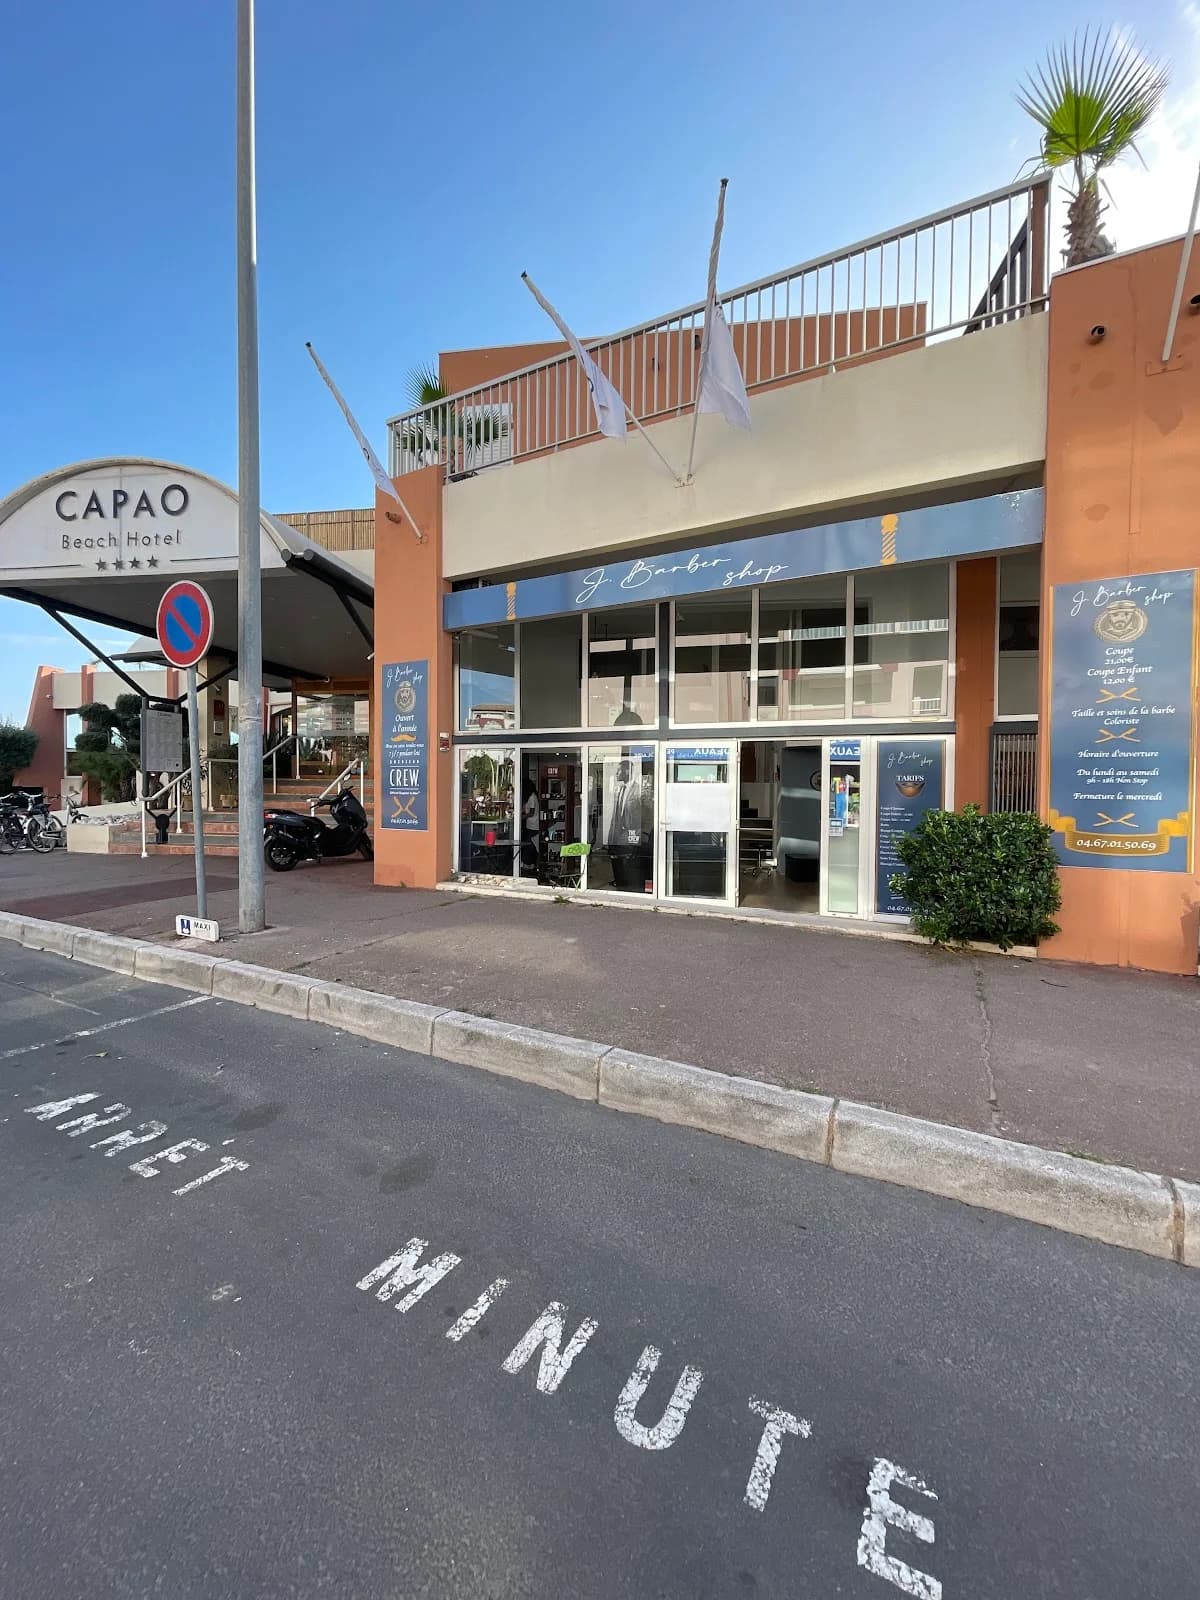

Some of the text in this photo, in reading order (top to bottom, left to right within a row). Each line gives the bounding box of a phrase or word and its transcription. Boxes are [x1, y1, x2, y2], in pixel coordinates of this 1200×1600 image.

[56, 483, 189, 522] CAPAO
[62, 529, 181, 549] Beach Hotel
[620, 553, 732, 589] Barber
[722, 560, 789, 587] shop
[1093, 582, 1147, 607] Barber
[1144, 588, 1174, 606] shop
[1105, 647, 1134, 658] Coupe
[1087, 664, 1153, 679] Coupe Enfant
[1072, 708, 1096, 717] Taille
[1106, 708, 1127, 716] soins
[1128, 706, 1139, 715] de
[1140, 705, 1149, 715] la
[1151, 704, 1176, 714] barbe
[395, 713, 415, 722] Ouvert
[1103, 717, 1140, 725] Coloriste
[1077, 748, 1159, 758] Horaire d'ouverture
[1076, 768, 1091, 776] Du
[1092, 767, 1115, 776] lundi
[1129, 767, 1160, 776] samedi
[1115, 776, 1132, 784] Non
[1132, 777, 1149, 786] Stop
[1073, 791, 1163, 801] Fermeture le mercredi
[1076, 838, 1157, 851] 04.67.01.50.69
[194, 921, 211, 931] MAXI
[356, 1237, 942, 1600] MINUTE
